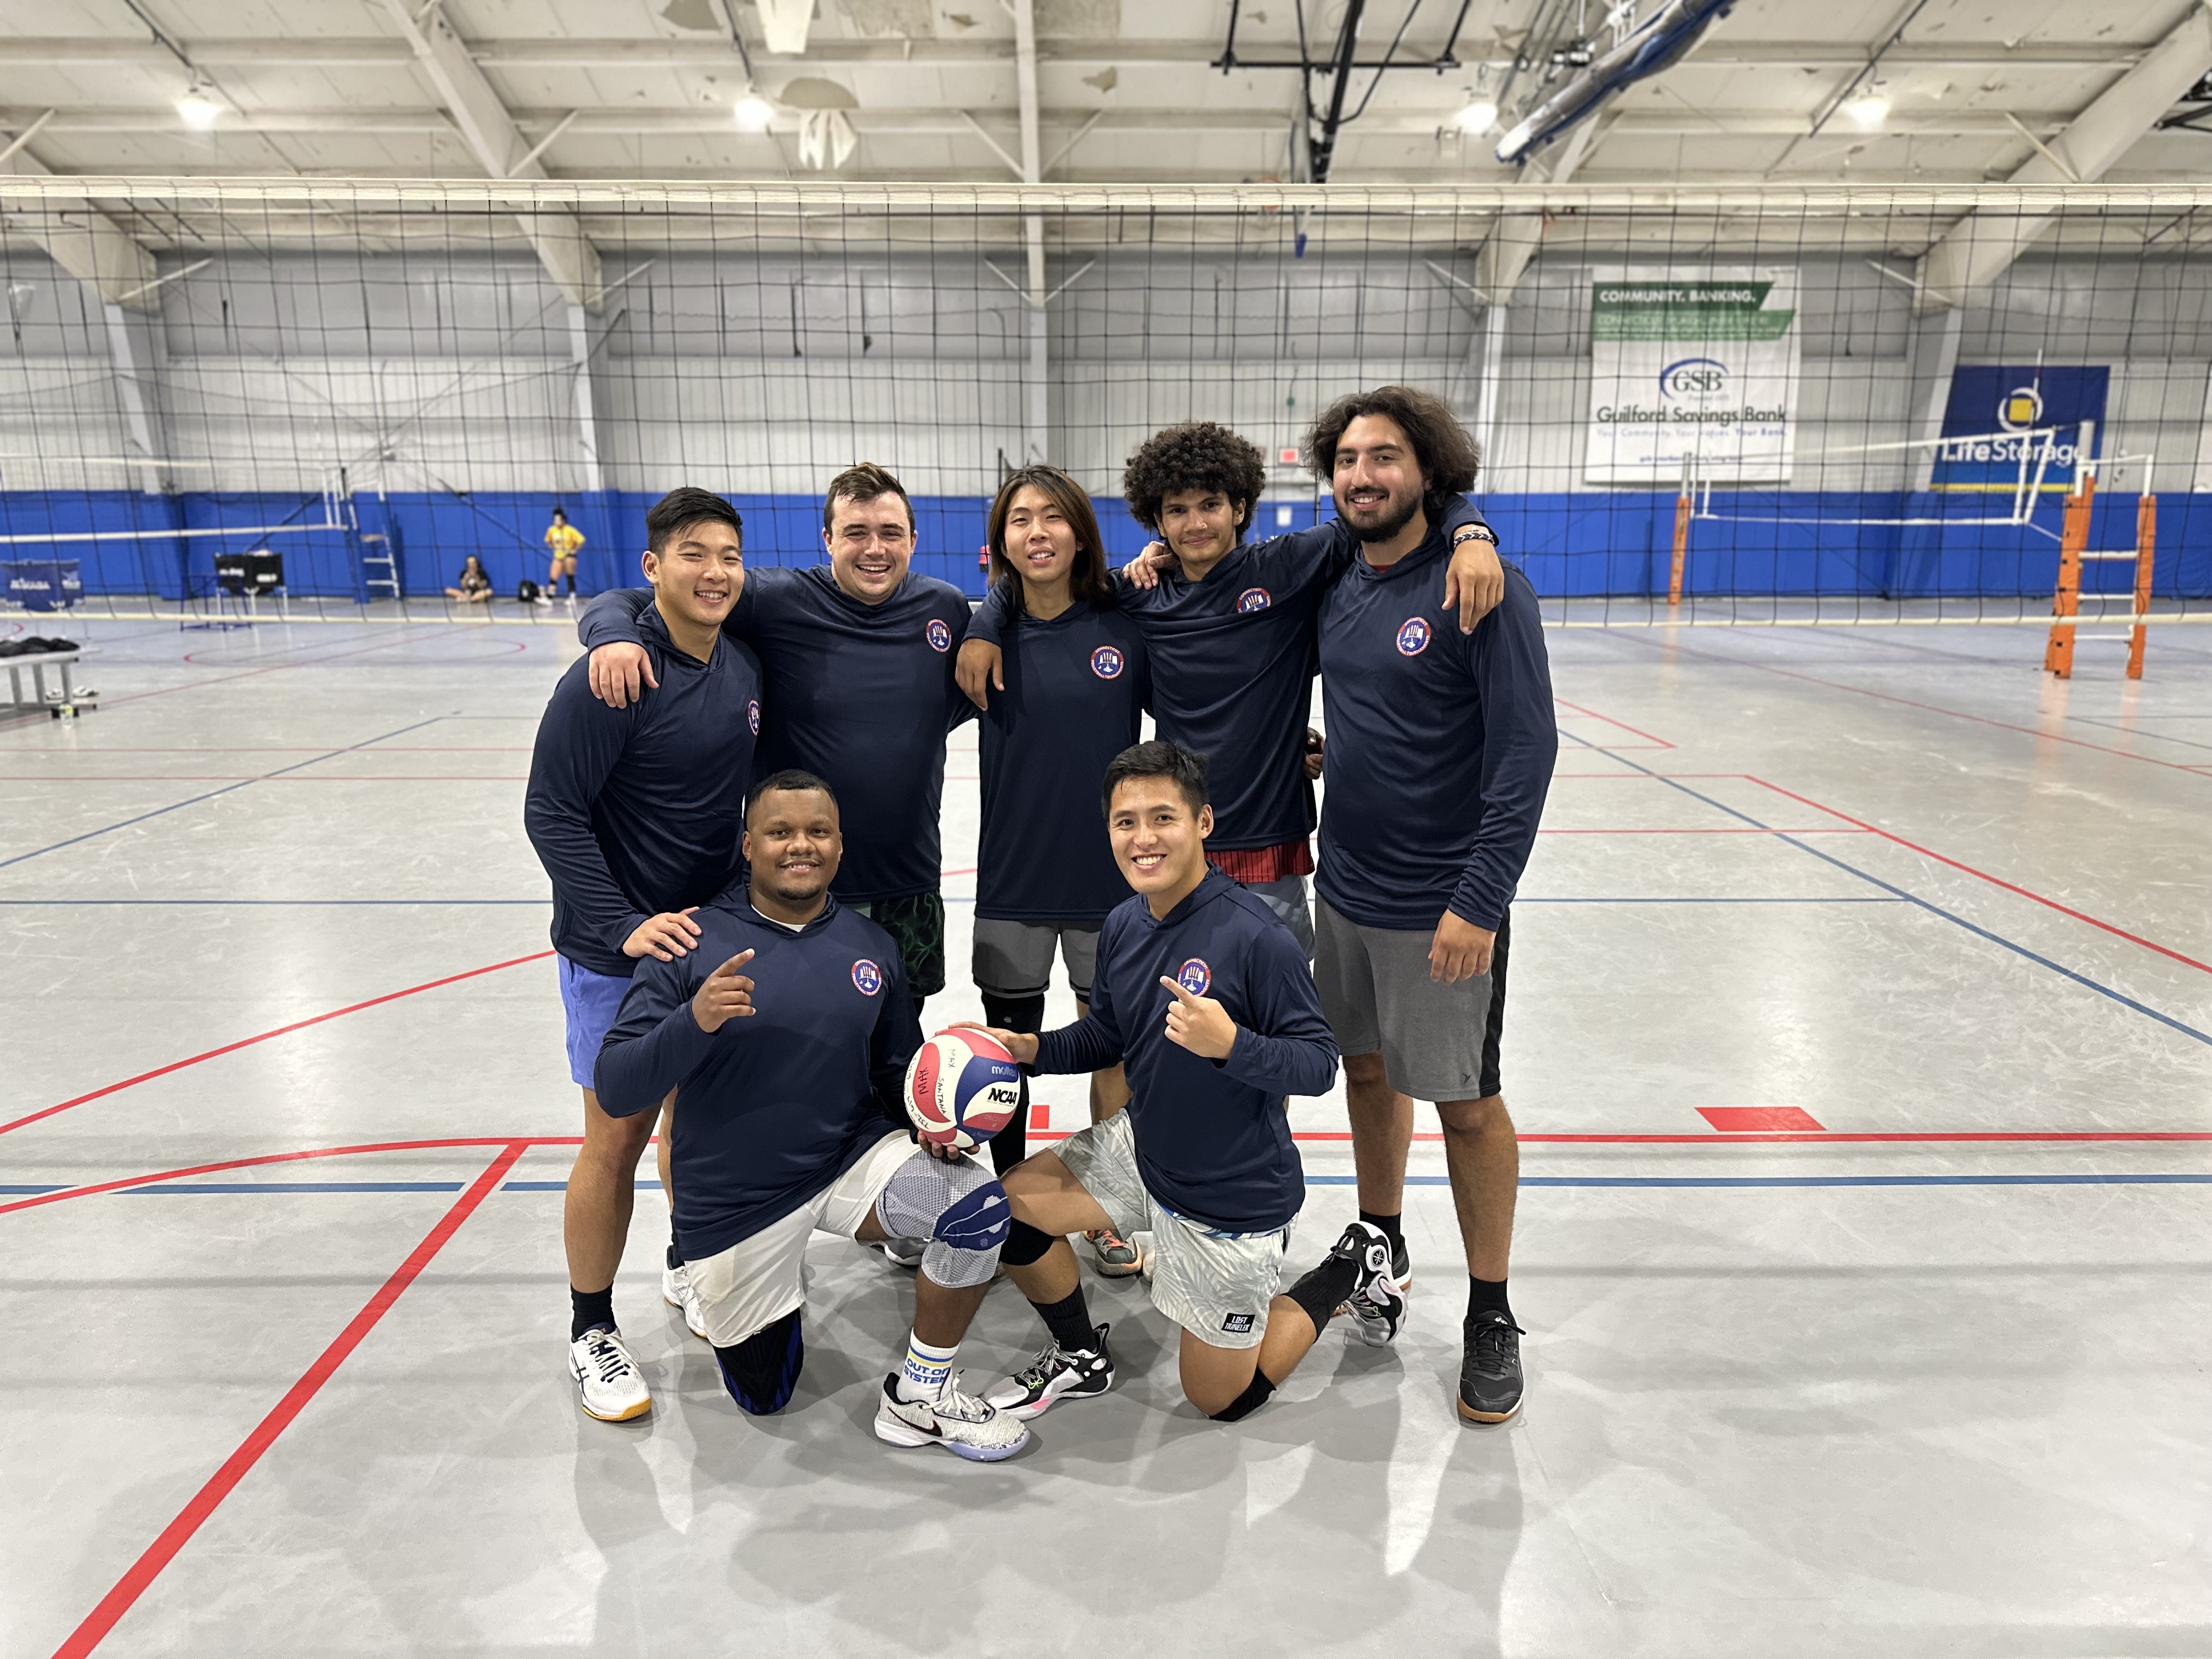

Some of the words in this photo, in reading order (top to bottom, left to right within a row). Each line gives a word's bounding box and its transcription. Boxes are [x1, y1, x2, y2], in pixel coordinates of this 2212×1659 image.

[1599, 290, 1686, 302] COMMUNITY.
[1689, 290, 1757, 303] BANKING.
[1673, 370, 1722, 392] GSB
[1597, 405, 1666, 422] Guilford
[1673, 407, 1739, 427] Savings
[1744, 404, 1787, 422] Bank
[947, 1048, 956, 1069] MAX
[991, 1065, 1018, 1078] molten
[937, 1075, 947, 1115] SANTANA
[988, 1087, 1017, 1105] NCAA
[1231, 1316, 1249, 1324] LOST
[907, 1357, 930, 1374] OUT
